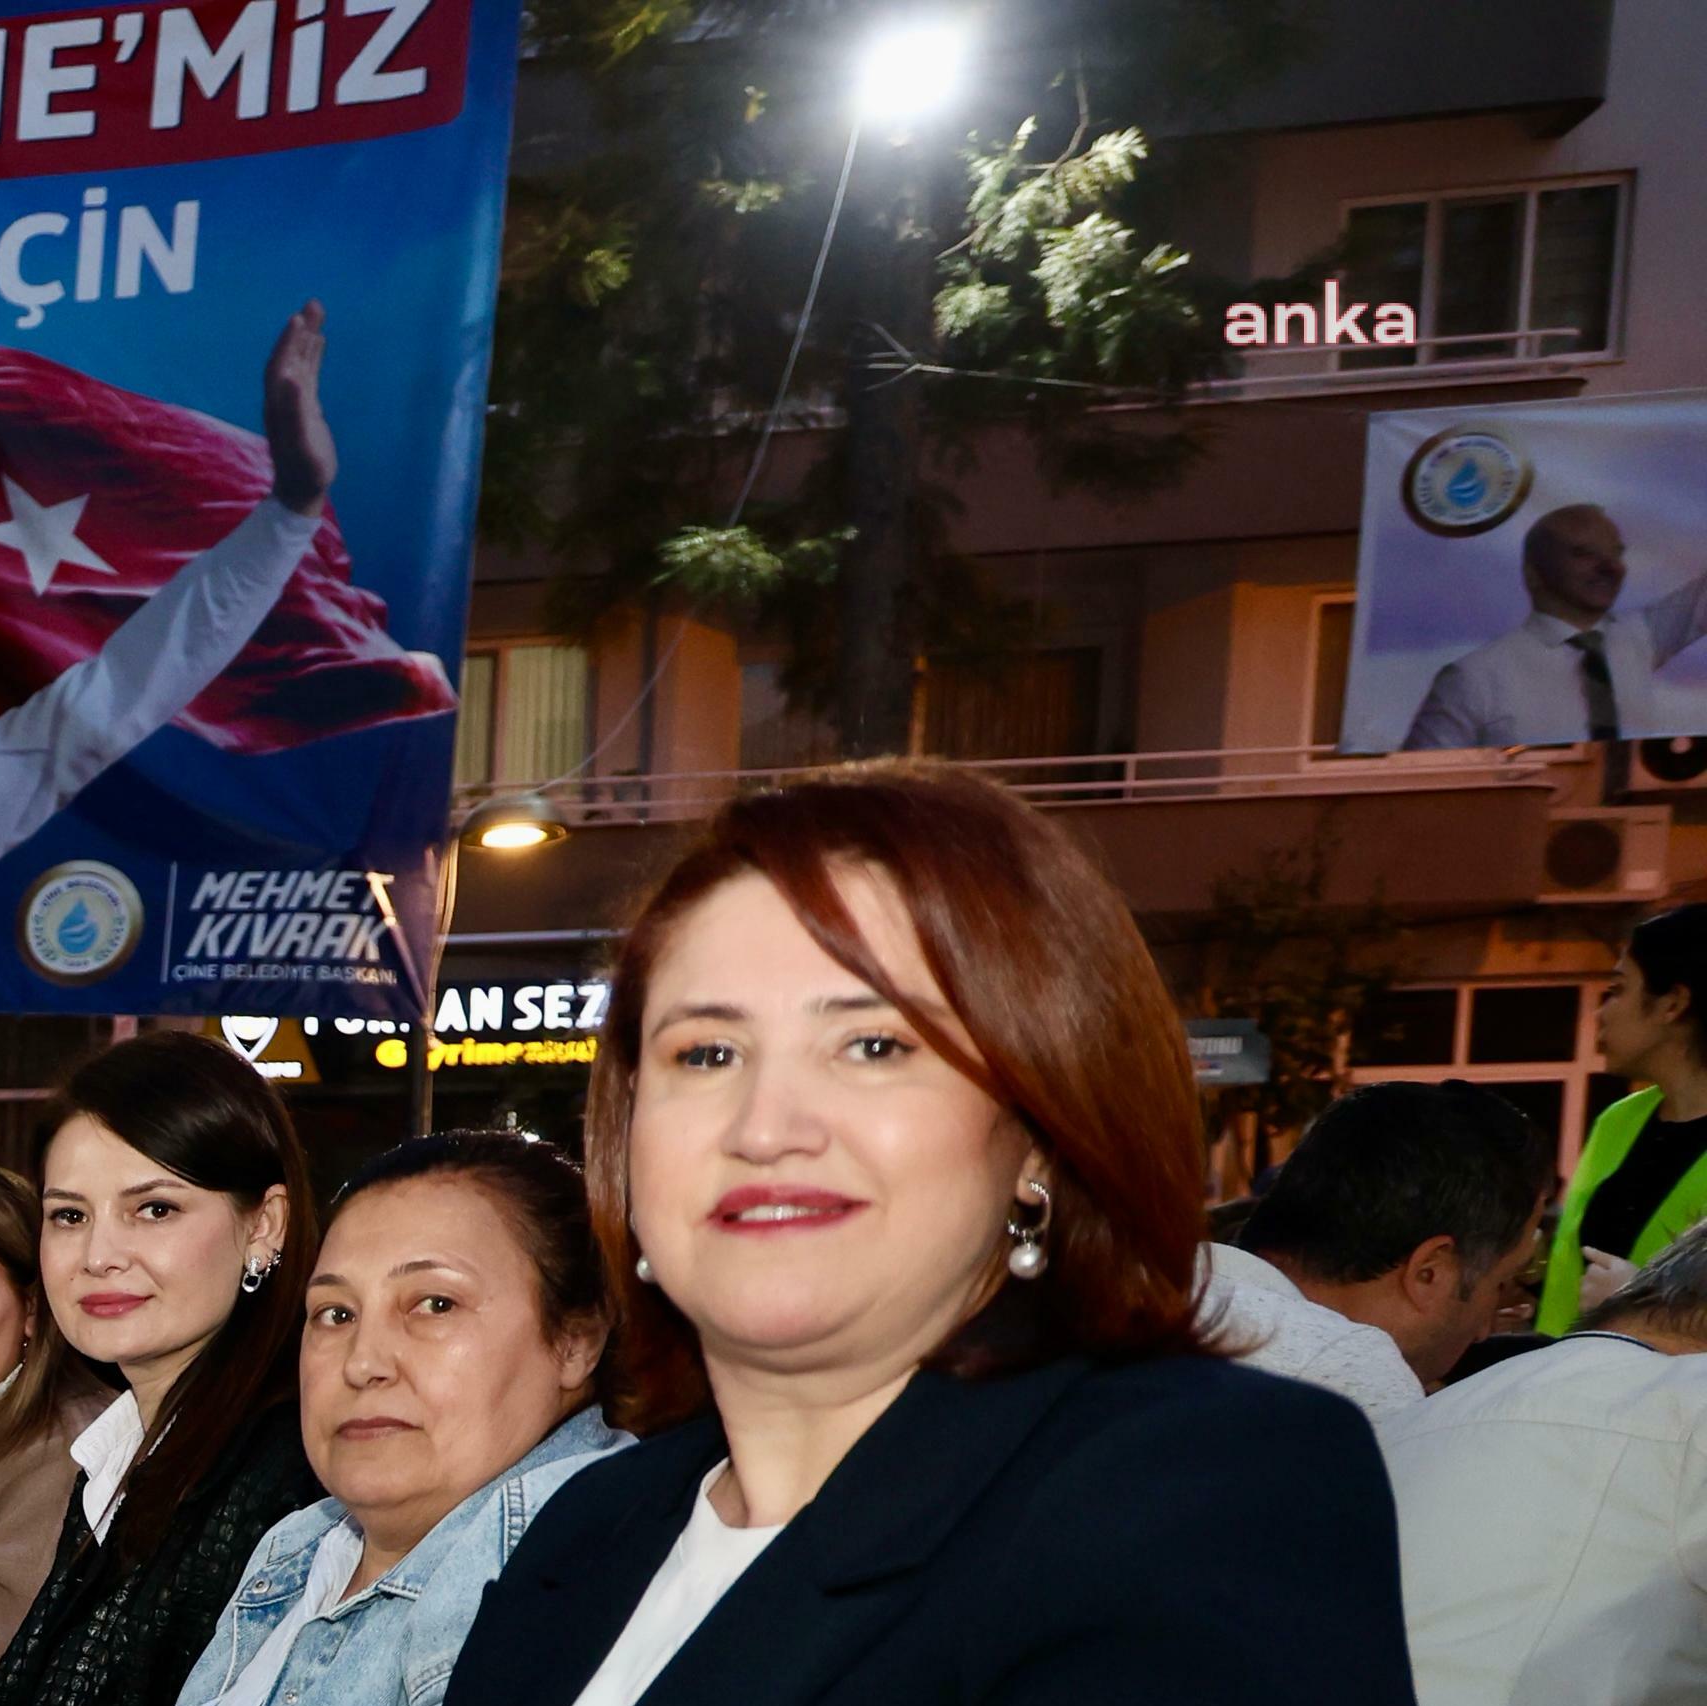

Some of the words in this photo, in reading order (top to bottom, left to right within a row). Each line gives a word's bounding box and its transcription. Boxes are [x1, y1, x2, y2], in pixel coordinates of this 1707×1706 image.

[189, 870, 395, 912] MEHMET
[184, 912, 389, 962] KIVRAK
[171, 962, 220, 983] ÇİNE
